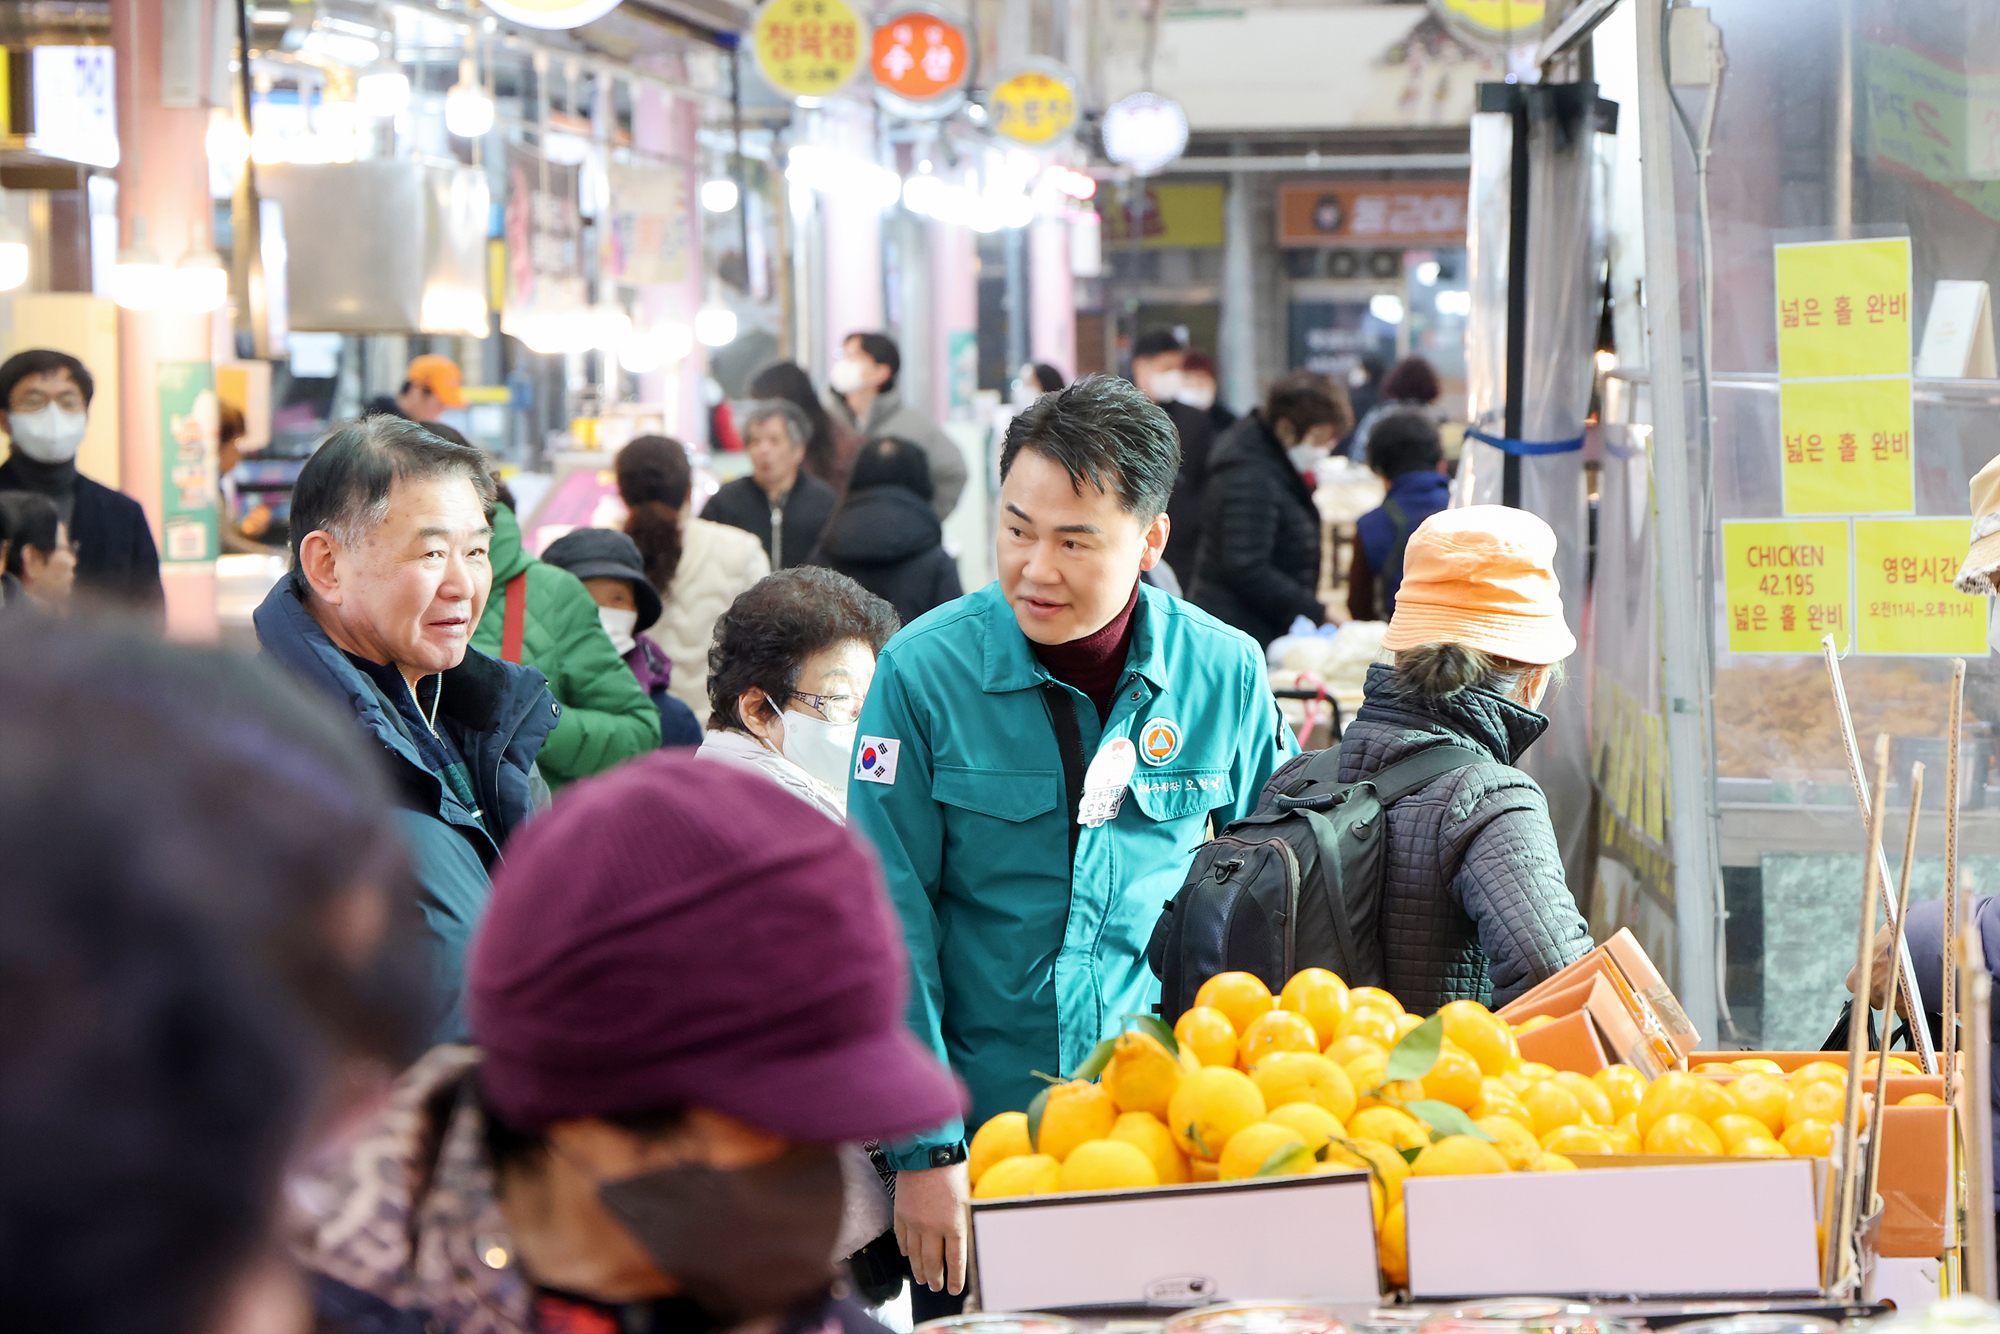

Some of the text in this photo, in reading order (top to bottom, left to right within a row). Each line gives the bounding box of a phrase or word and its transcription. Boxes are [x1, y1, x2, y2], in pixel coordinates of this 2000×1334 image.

[1781, 292, 1907, 328] 넓은 홀 완비
[1786, 430, 1910, 464] 넓은 홀 완비
[1747, 545, 1824, 567] CHICKEN
[1883, 557, 1959, 583] 영업시간
[1759, 574, 1815, 596] 42.195
[1734, 603, 1843, 632] 넓은 홀 완비
